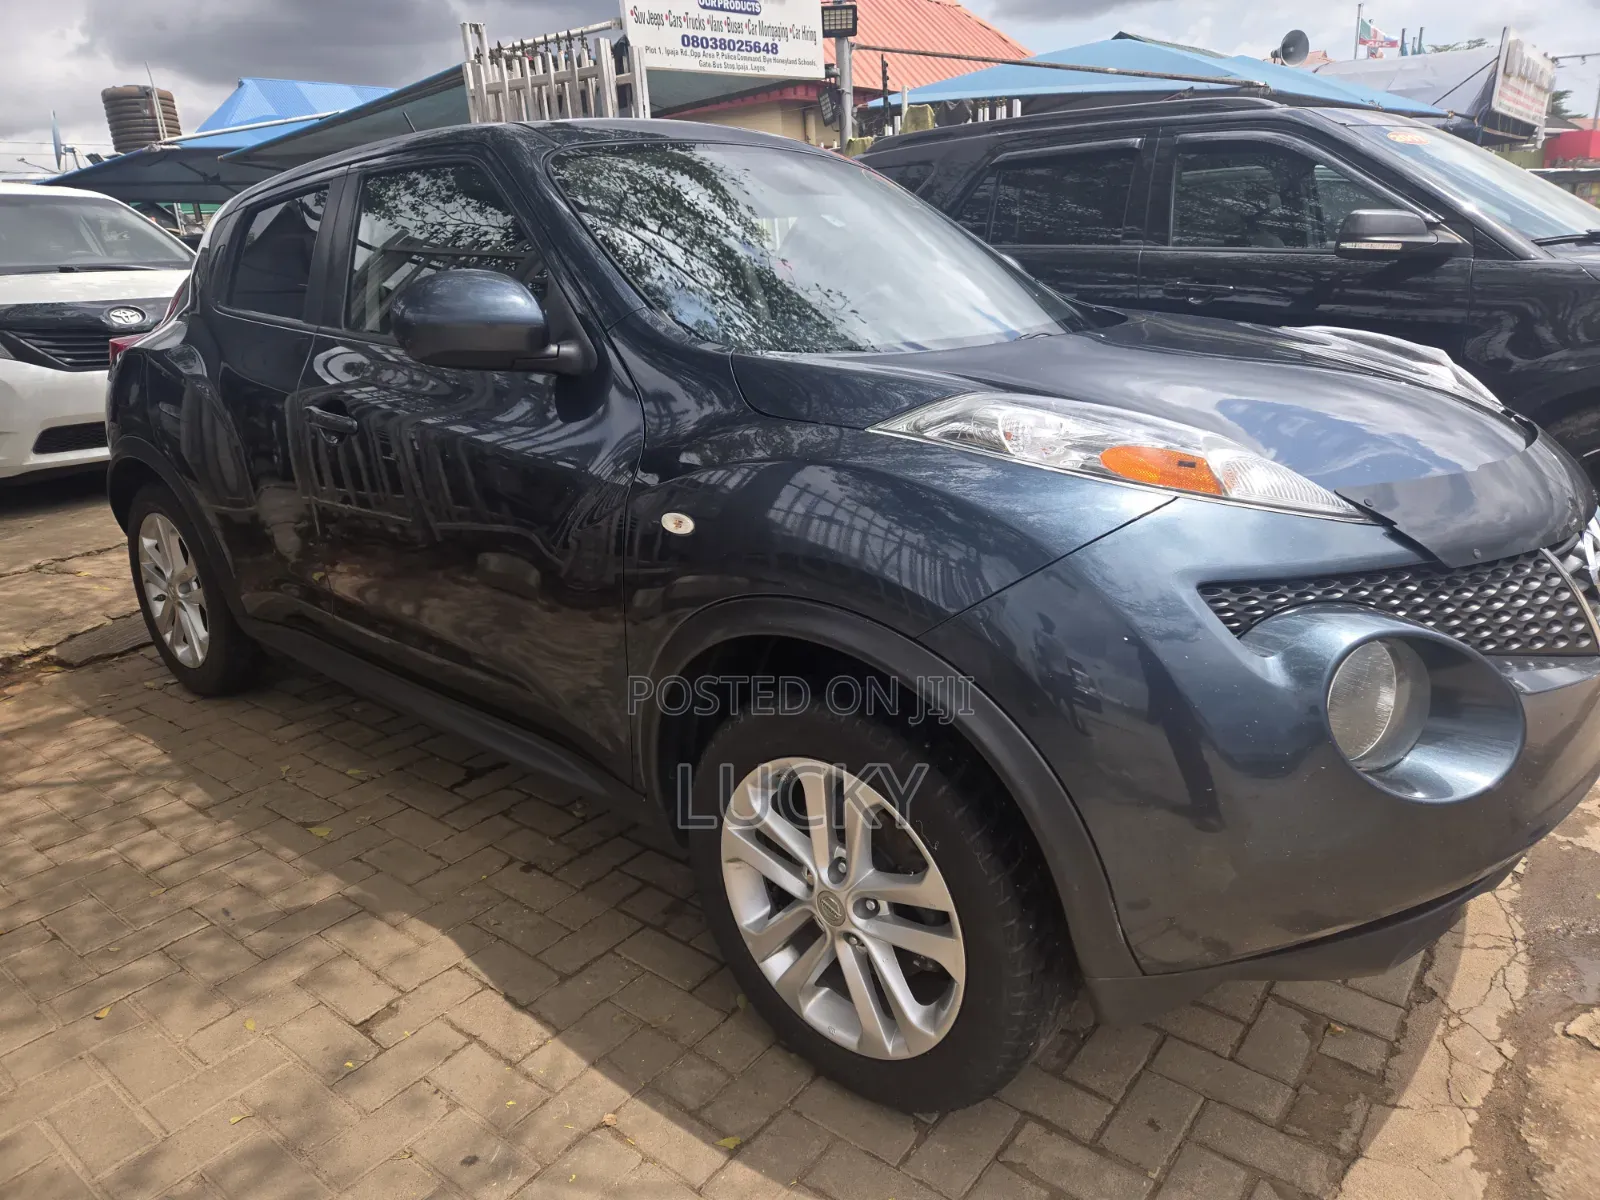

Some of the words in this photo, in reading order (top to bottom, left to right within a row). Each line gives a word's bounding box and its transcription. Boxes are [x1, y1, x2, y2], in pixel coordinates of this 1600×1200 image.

[718, 0, 761, 12] PRODUCTS
[647, 10, 664, 30] Jeeps
[668, 10, 683, 28] Cars
[685, 12, 706, 31] Trucks
[709, 14, 723, 32] Vans
[727, 16, 744, 34] Buses
[748, 19, 757, 35] Car
[758, 20, 789, 42] Mortgaging
[792, 24, 801, 40] Car
[801, 25, 817, 45] Hiring
[681, 34, 779, 55] 08038025648
[645, 46, 657, 54] Plot
[665, 47, 679, 57] Ipaja
[702, 50, 715, 58] Area
[713, 61, 722, 69] Bus
